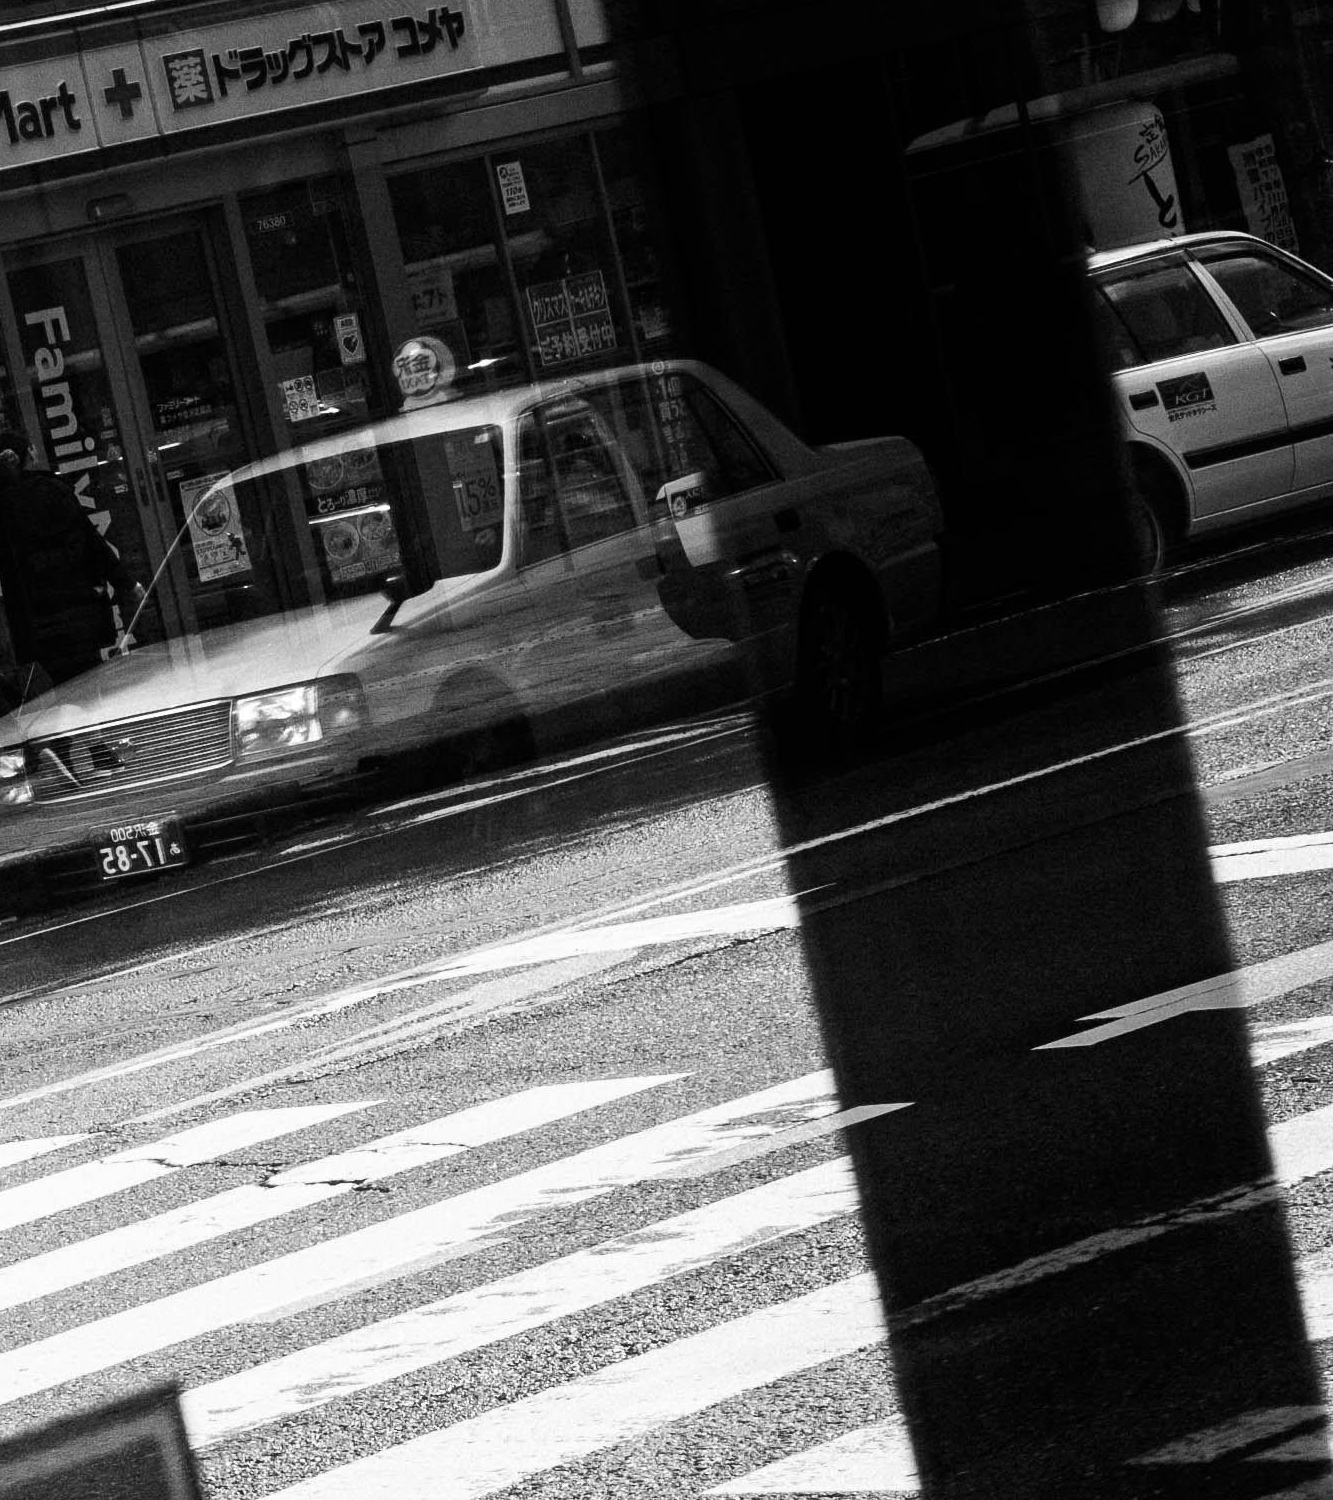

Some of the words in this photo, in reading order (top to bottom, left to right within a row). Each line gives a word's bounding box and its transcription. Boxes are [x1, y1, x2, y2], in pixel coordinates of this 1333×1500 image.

[167, 53, 213, 106] 薬
[213, 20, 387, 97] ドラッグストア
[393, 5, 464, 58] コメヤ
